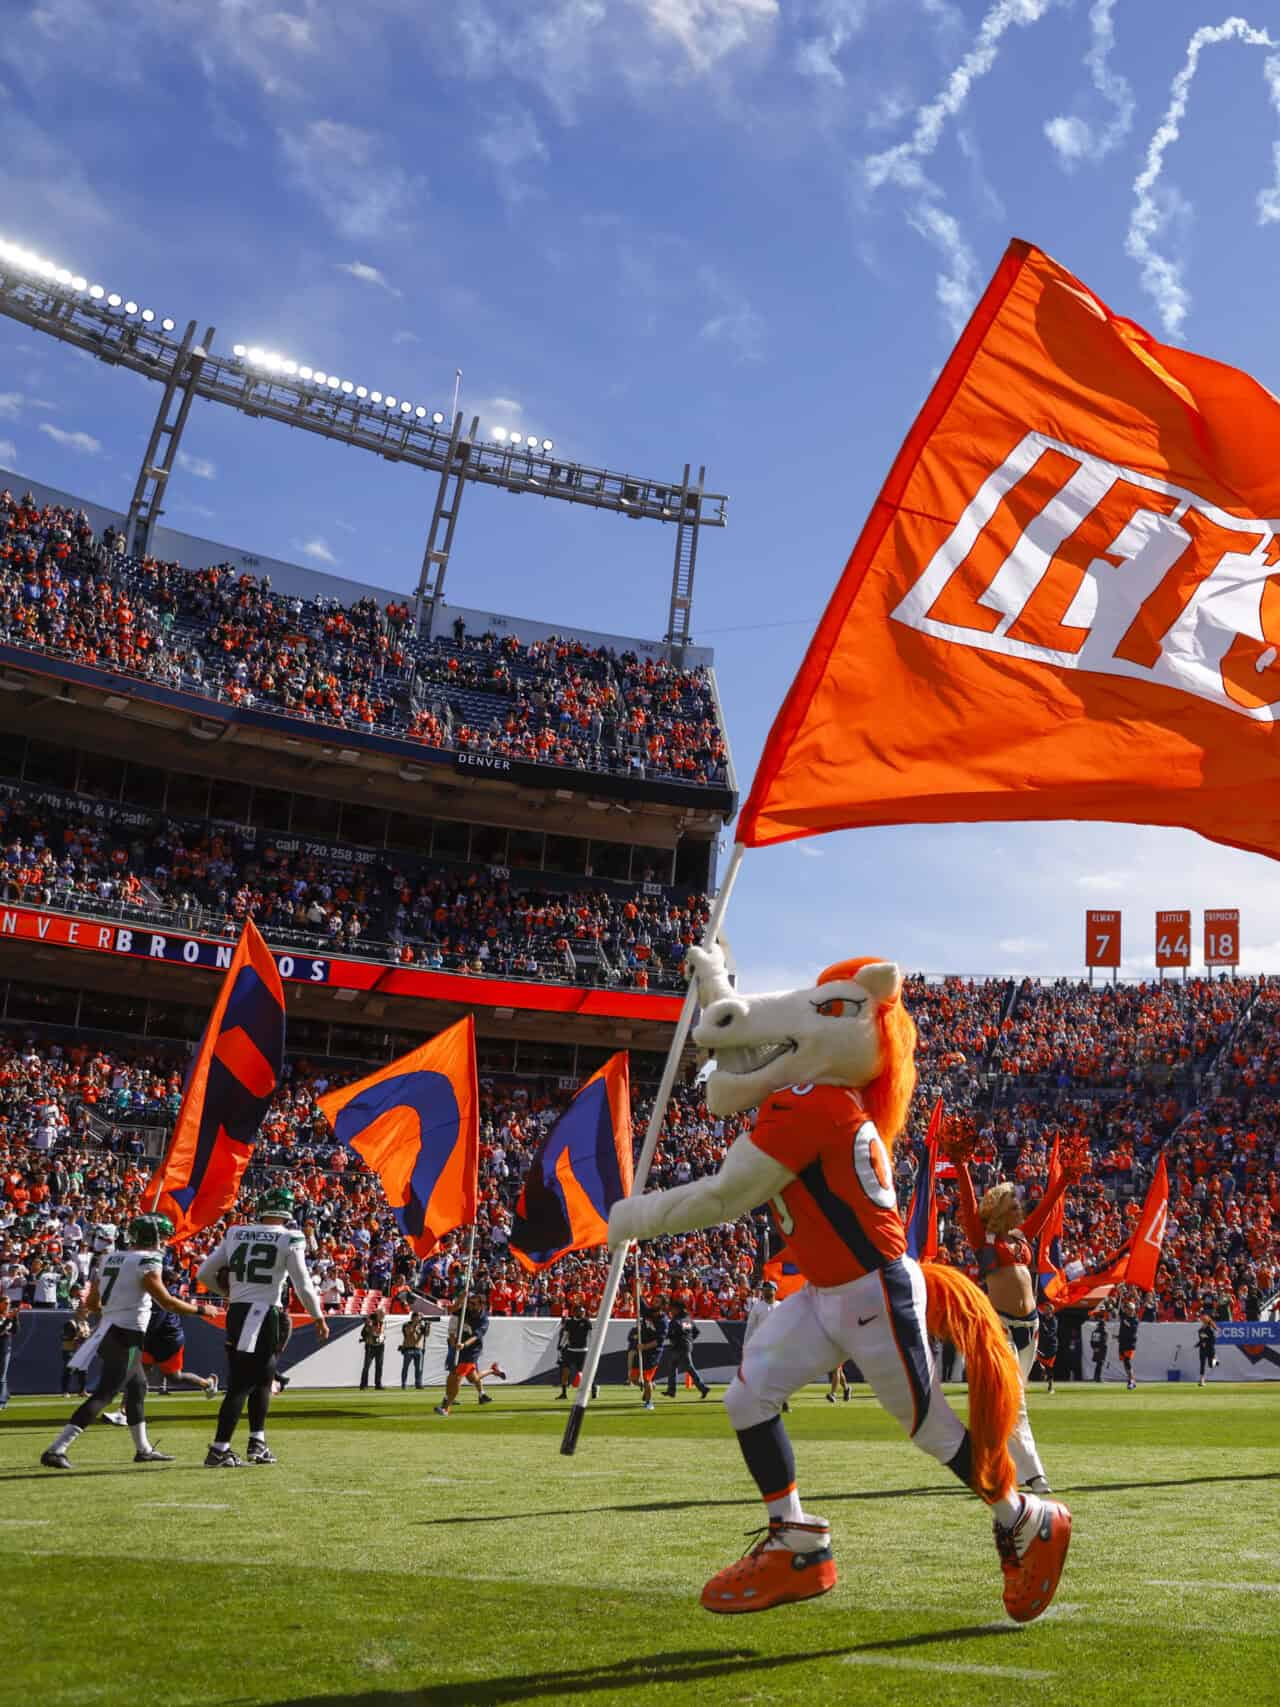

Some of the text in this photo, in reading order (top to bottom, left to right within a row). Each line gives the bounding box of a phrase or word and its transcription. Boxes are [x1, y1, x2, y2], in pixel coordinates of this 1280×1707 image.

[458, 754, 511, 771] DENVER
[116, 927, 326, 982] BRONOS
[1096, 935, 1111, 958] 7
[1157, 935, 1189, 959] 44
[1209, 934, 1233, 958] 18
[229, 1242, 278, 1285] 42
[103, 1267, 120, 1306] 7
[1222, 1327, 1276, 1338] CBS NFL
